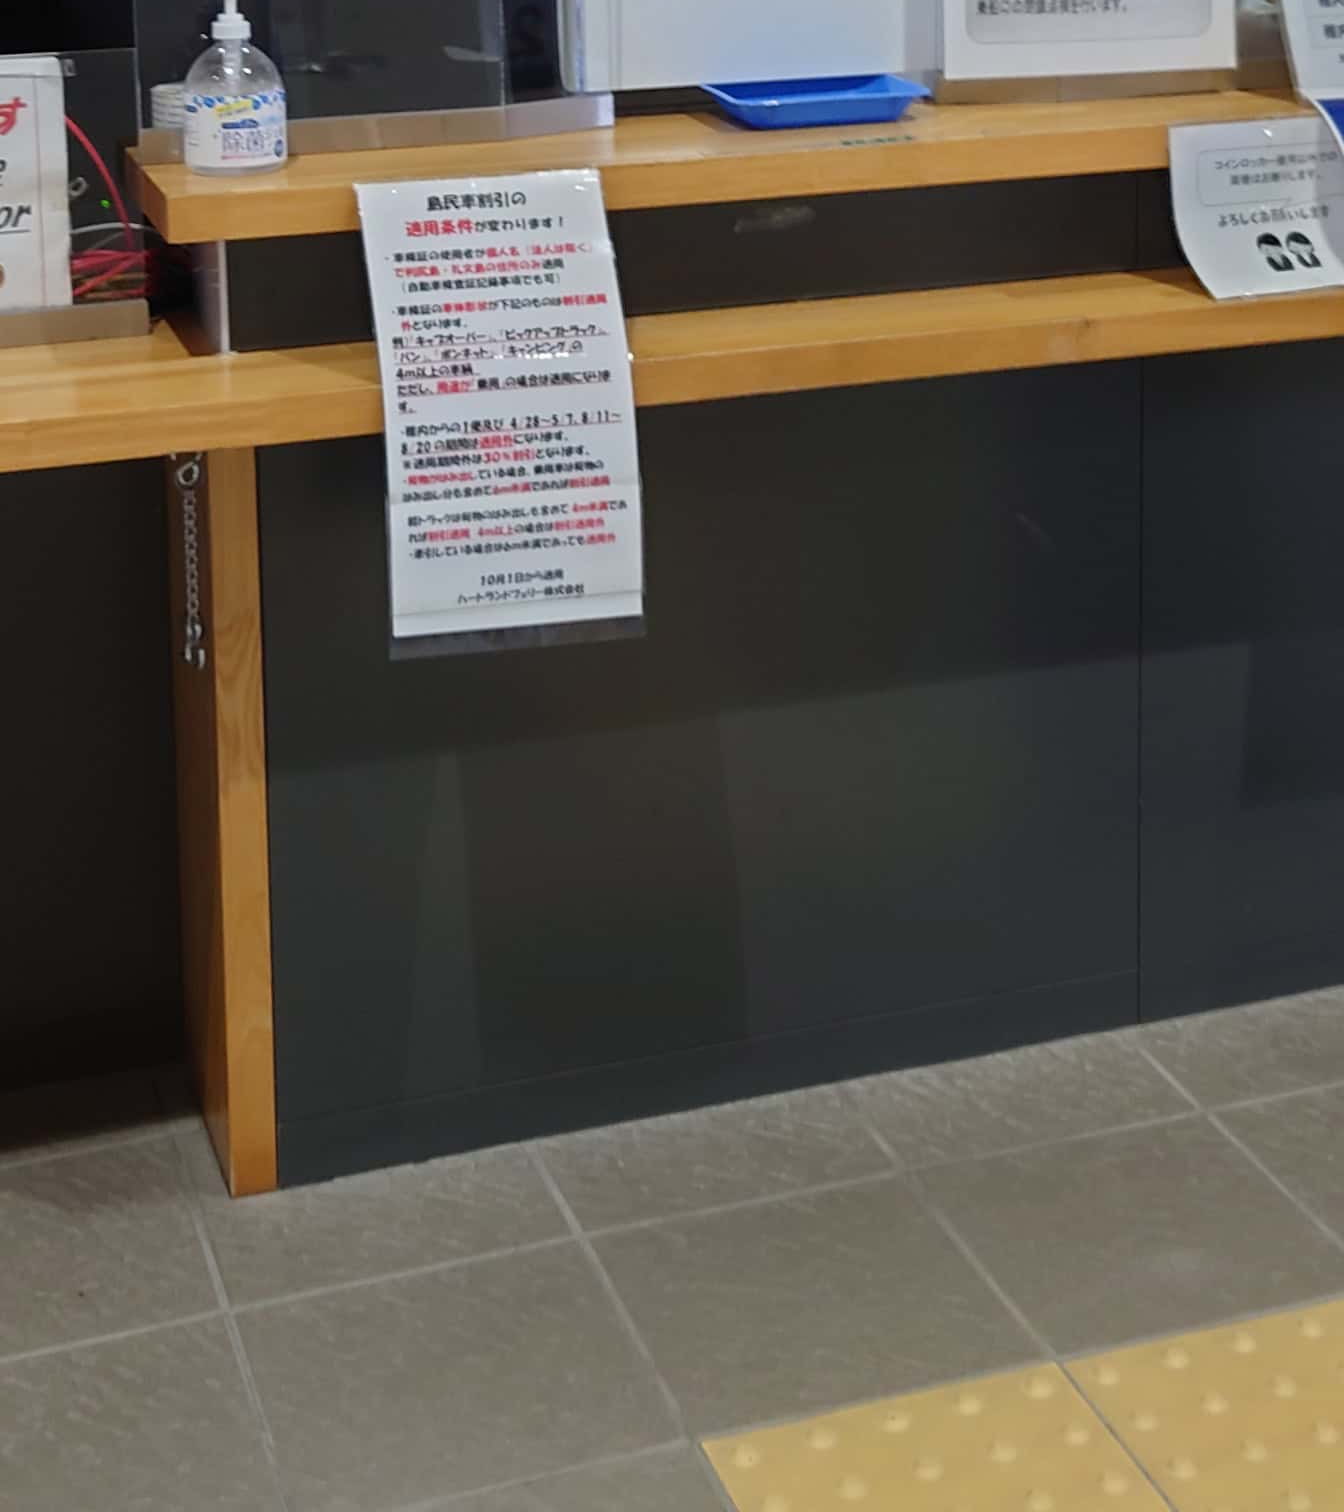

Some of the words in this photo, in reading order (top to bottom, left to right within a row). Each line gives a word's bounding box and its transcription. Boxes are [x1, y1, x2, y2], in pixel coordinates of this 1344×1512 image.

[426, 191, 527, 212] 島民車割引の
